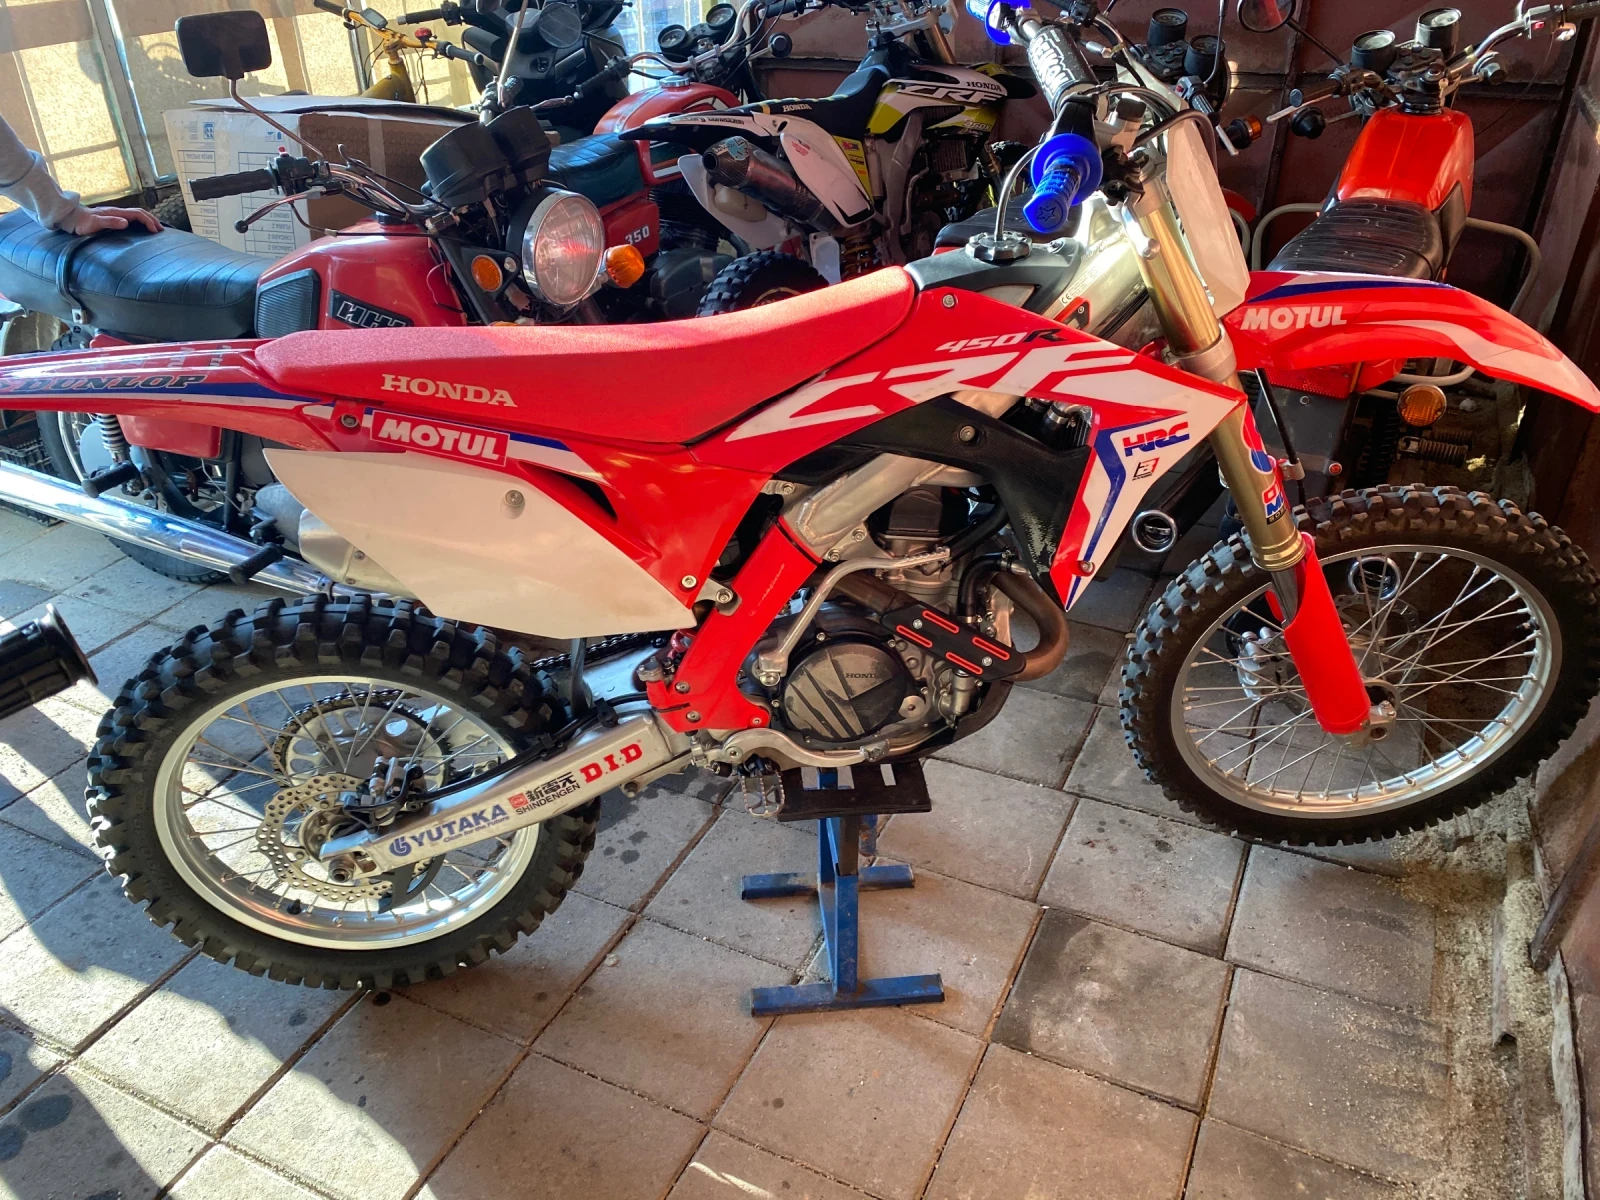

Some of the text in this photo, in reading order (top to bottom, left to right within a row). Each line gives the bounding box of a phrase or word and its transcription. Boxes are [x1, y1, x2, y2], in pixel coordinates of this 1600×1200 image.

[896, 84, 1003, 103] CRF
[966, 81, 1003, 92] HONDA
[782, 103, 812, 112] HONDA
[625, 225, 650, 245] 350
[1240, 306, 1347, 330] MOTUL
[934, 328, 1067, 353] 450R
[12, 375, 208, 392] DUNLOP
[381, 373, 518, 408] HONDA
[724, 340, 1137, 442] CRF
[378, 418, 500, 461] MOTUL
[1122, 421, 1190, 457] HRC
[515, 783, 581, 816] SHINDENGEN
[410, 804, 508, 847] YUTAKA
[443, 815, 510, 843] Clean for the Future
